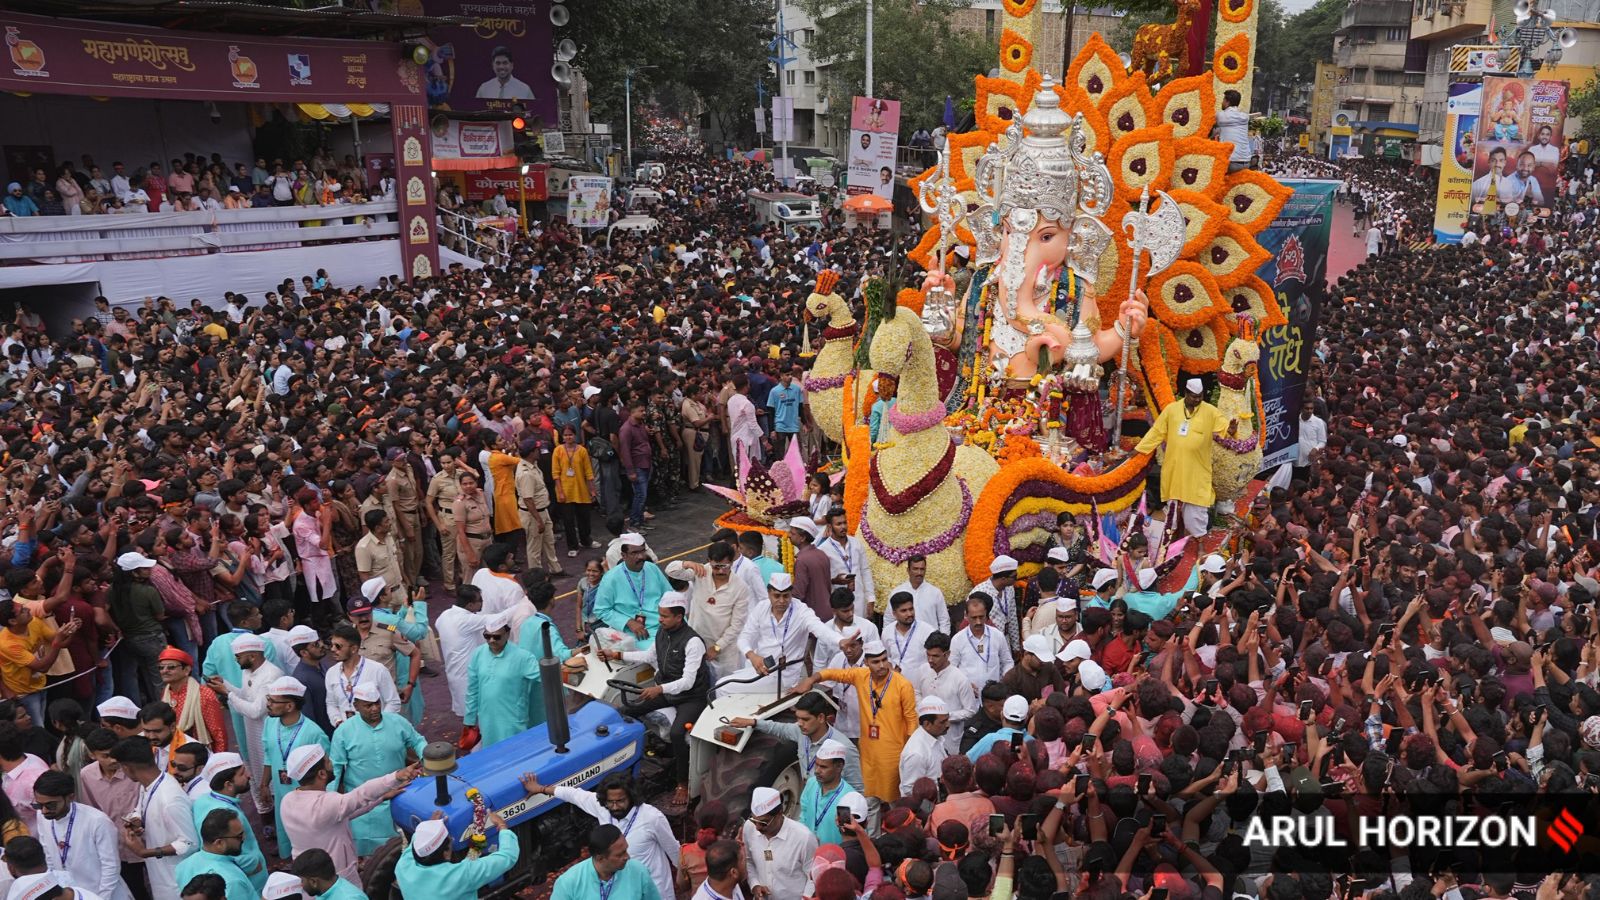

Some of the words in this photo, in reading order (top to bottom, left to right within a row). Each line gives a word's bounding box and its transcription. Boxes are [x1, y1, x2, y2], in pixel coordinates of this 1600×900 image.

[81, 37, 196, 71] महागणेशोत्सव
[1269, 326, 1303, 380] राधे
[567, 765, 601, 788] HOLLAND
[502, 802, 526, 819] 3630
